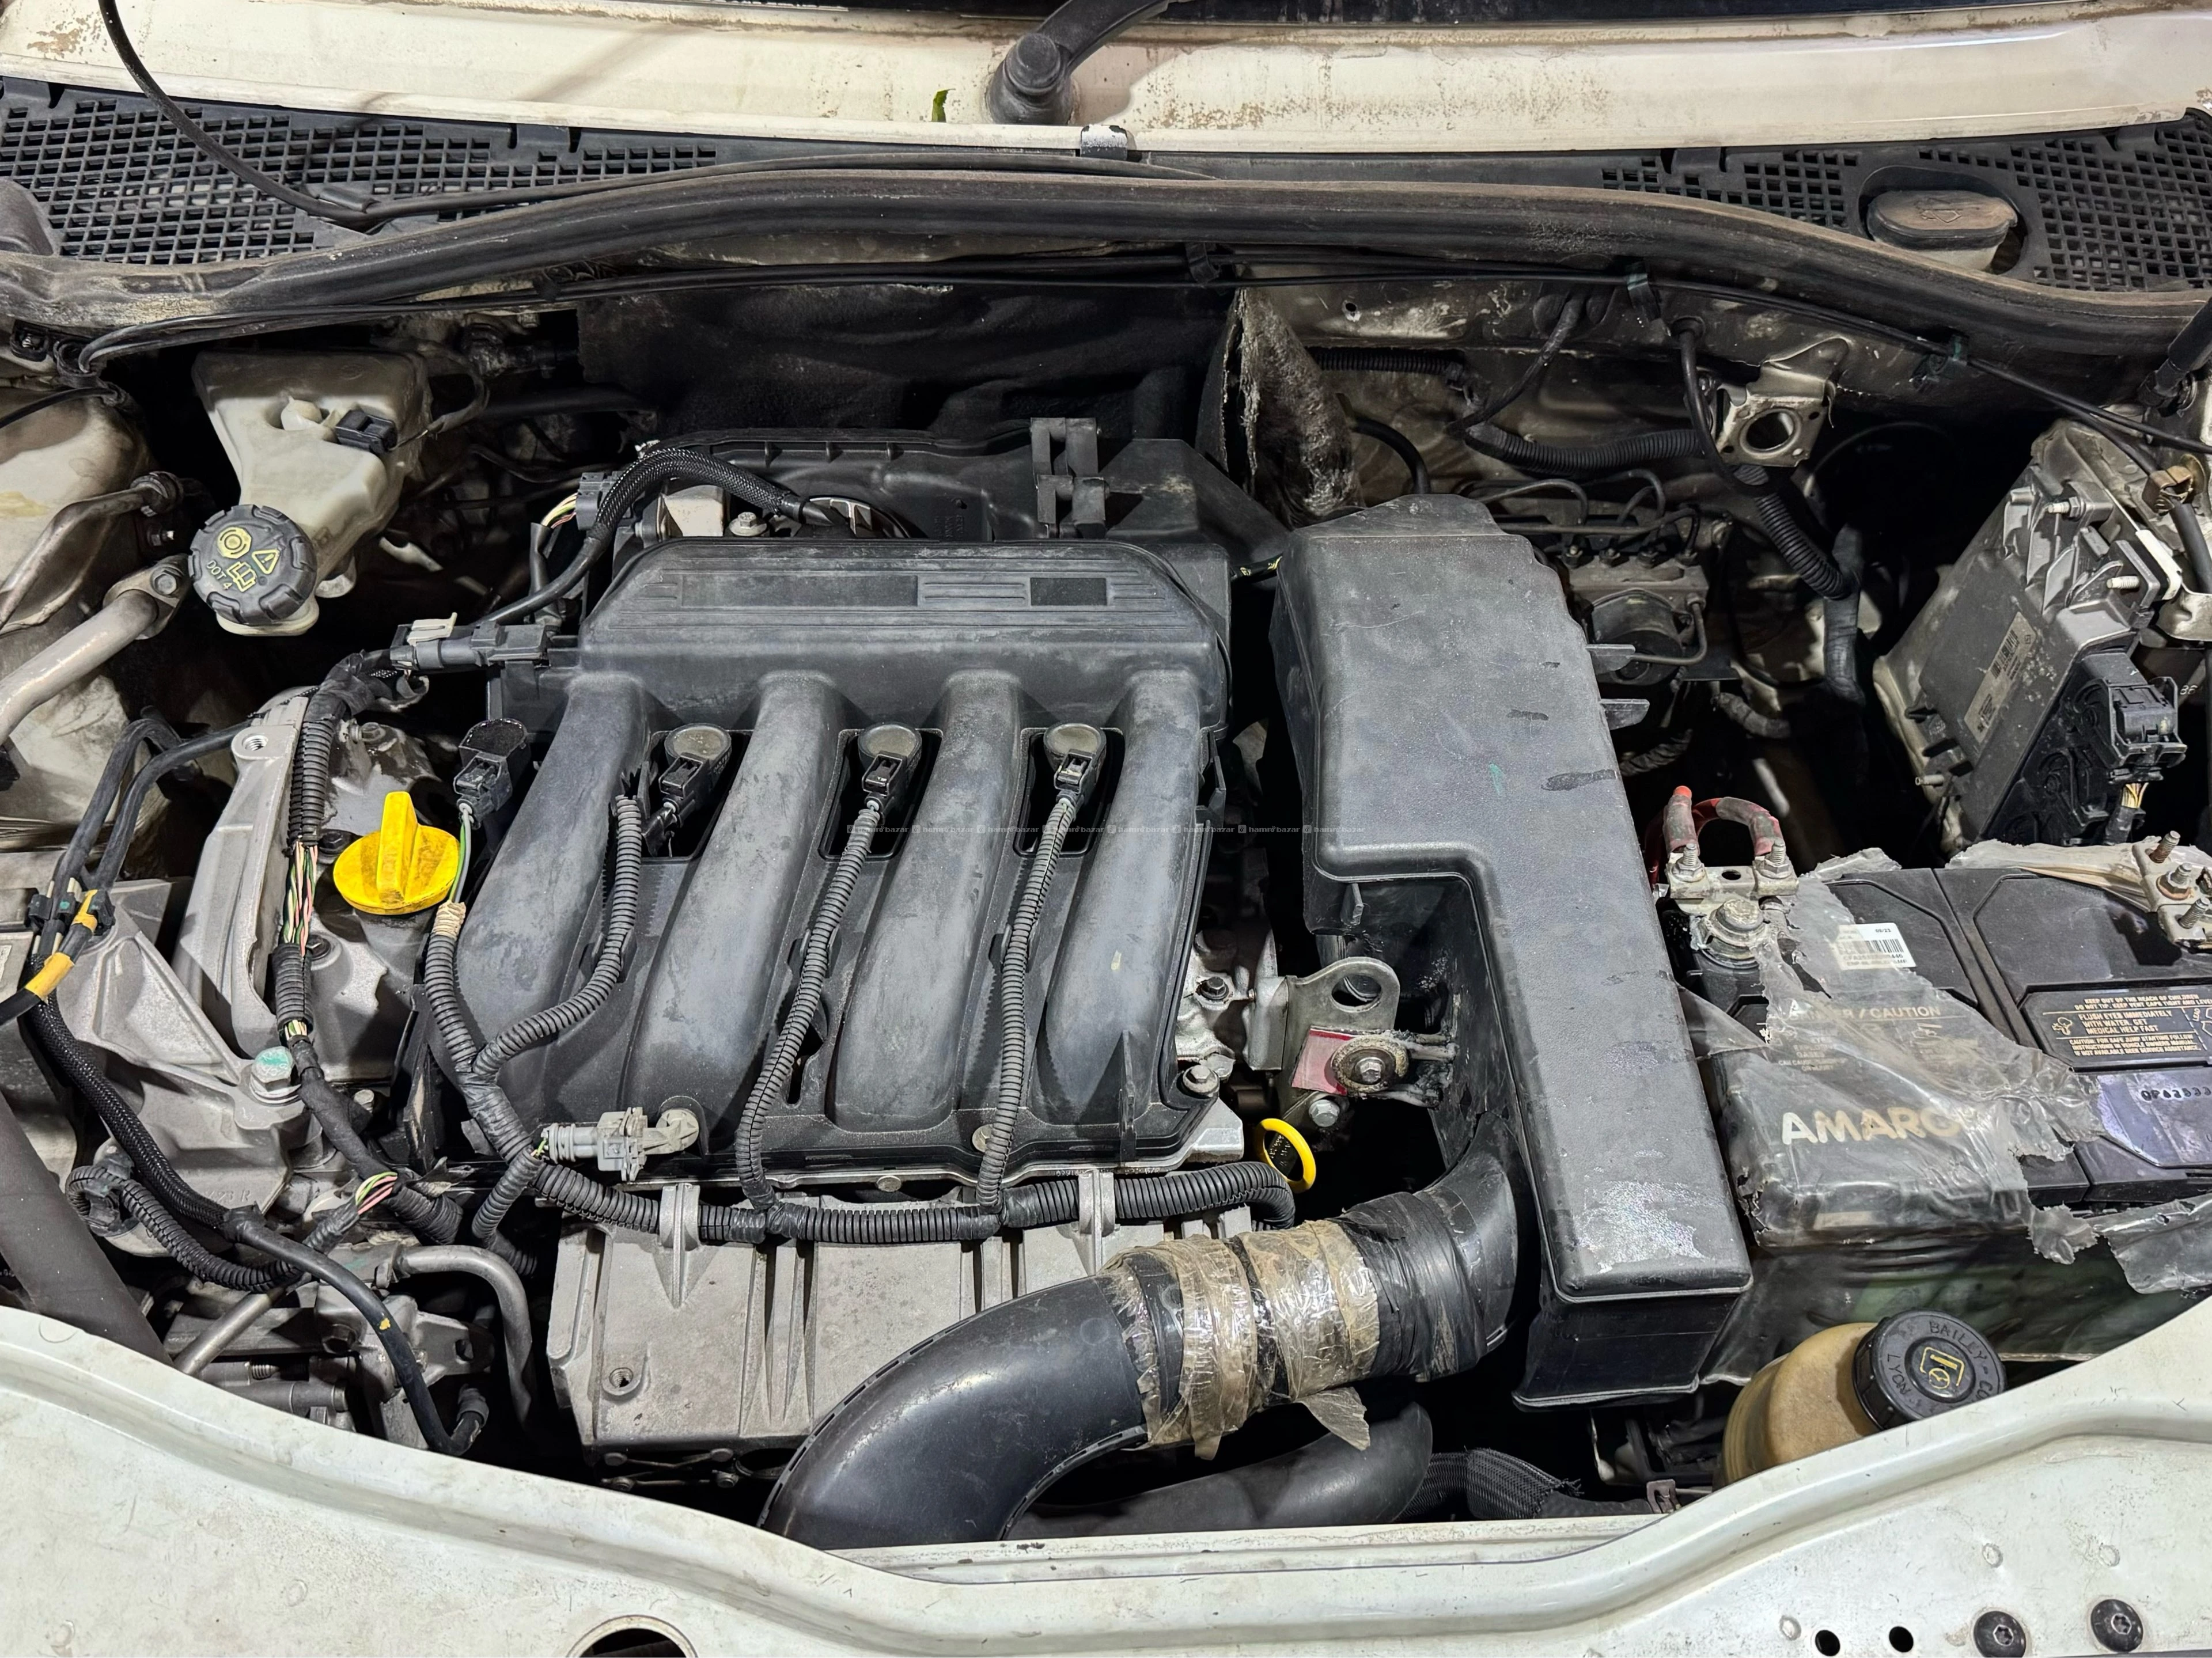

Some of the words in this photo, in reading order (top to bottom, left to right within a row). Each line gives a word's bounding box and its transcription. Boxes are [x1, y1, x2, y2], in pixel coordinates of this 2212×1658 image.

[206, 560, 226, 580] DOT
[222, 581, 232, 590] 4
[1870, 1007, 1941, 1019] CAUTION
[2123, 1010, 2172, 1018] IMMEDIATELY
[1887, 1353, 1912, 1395] LYON
